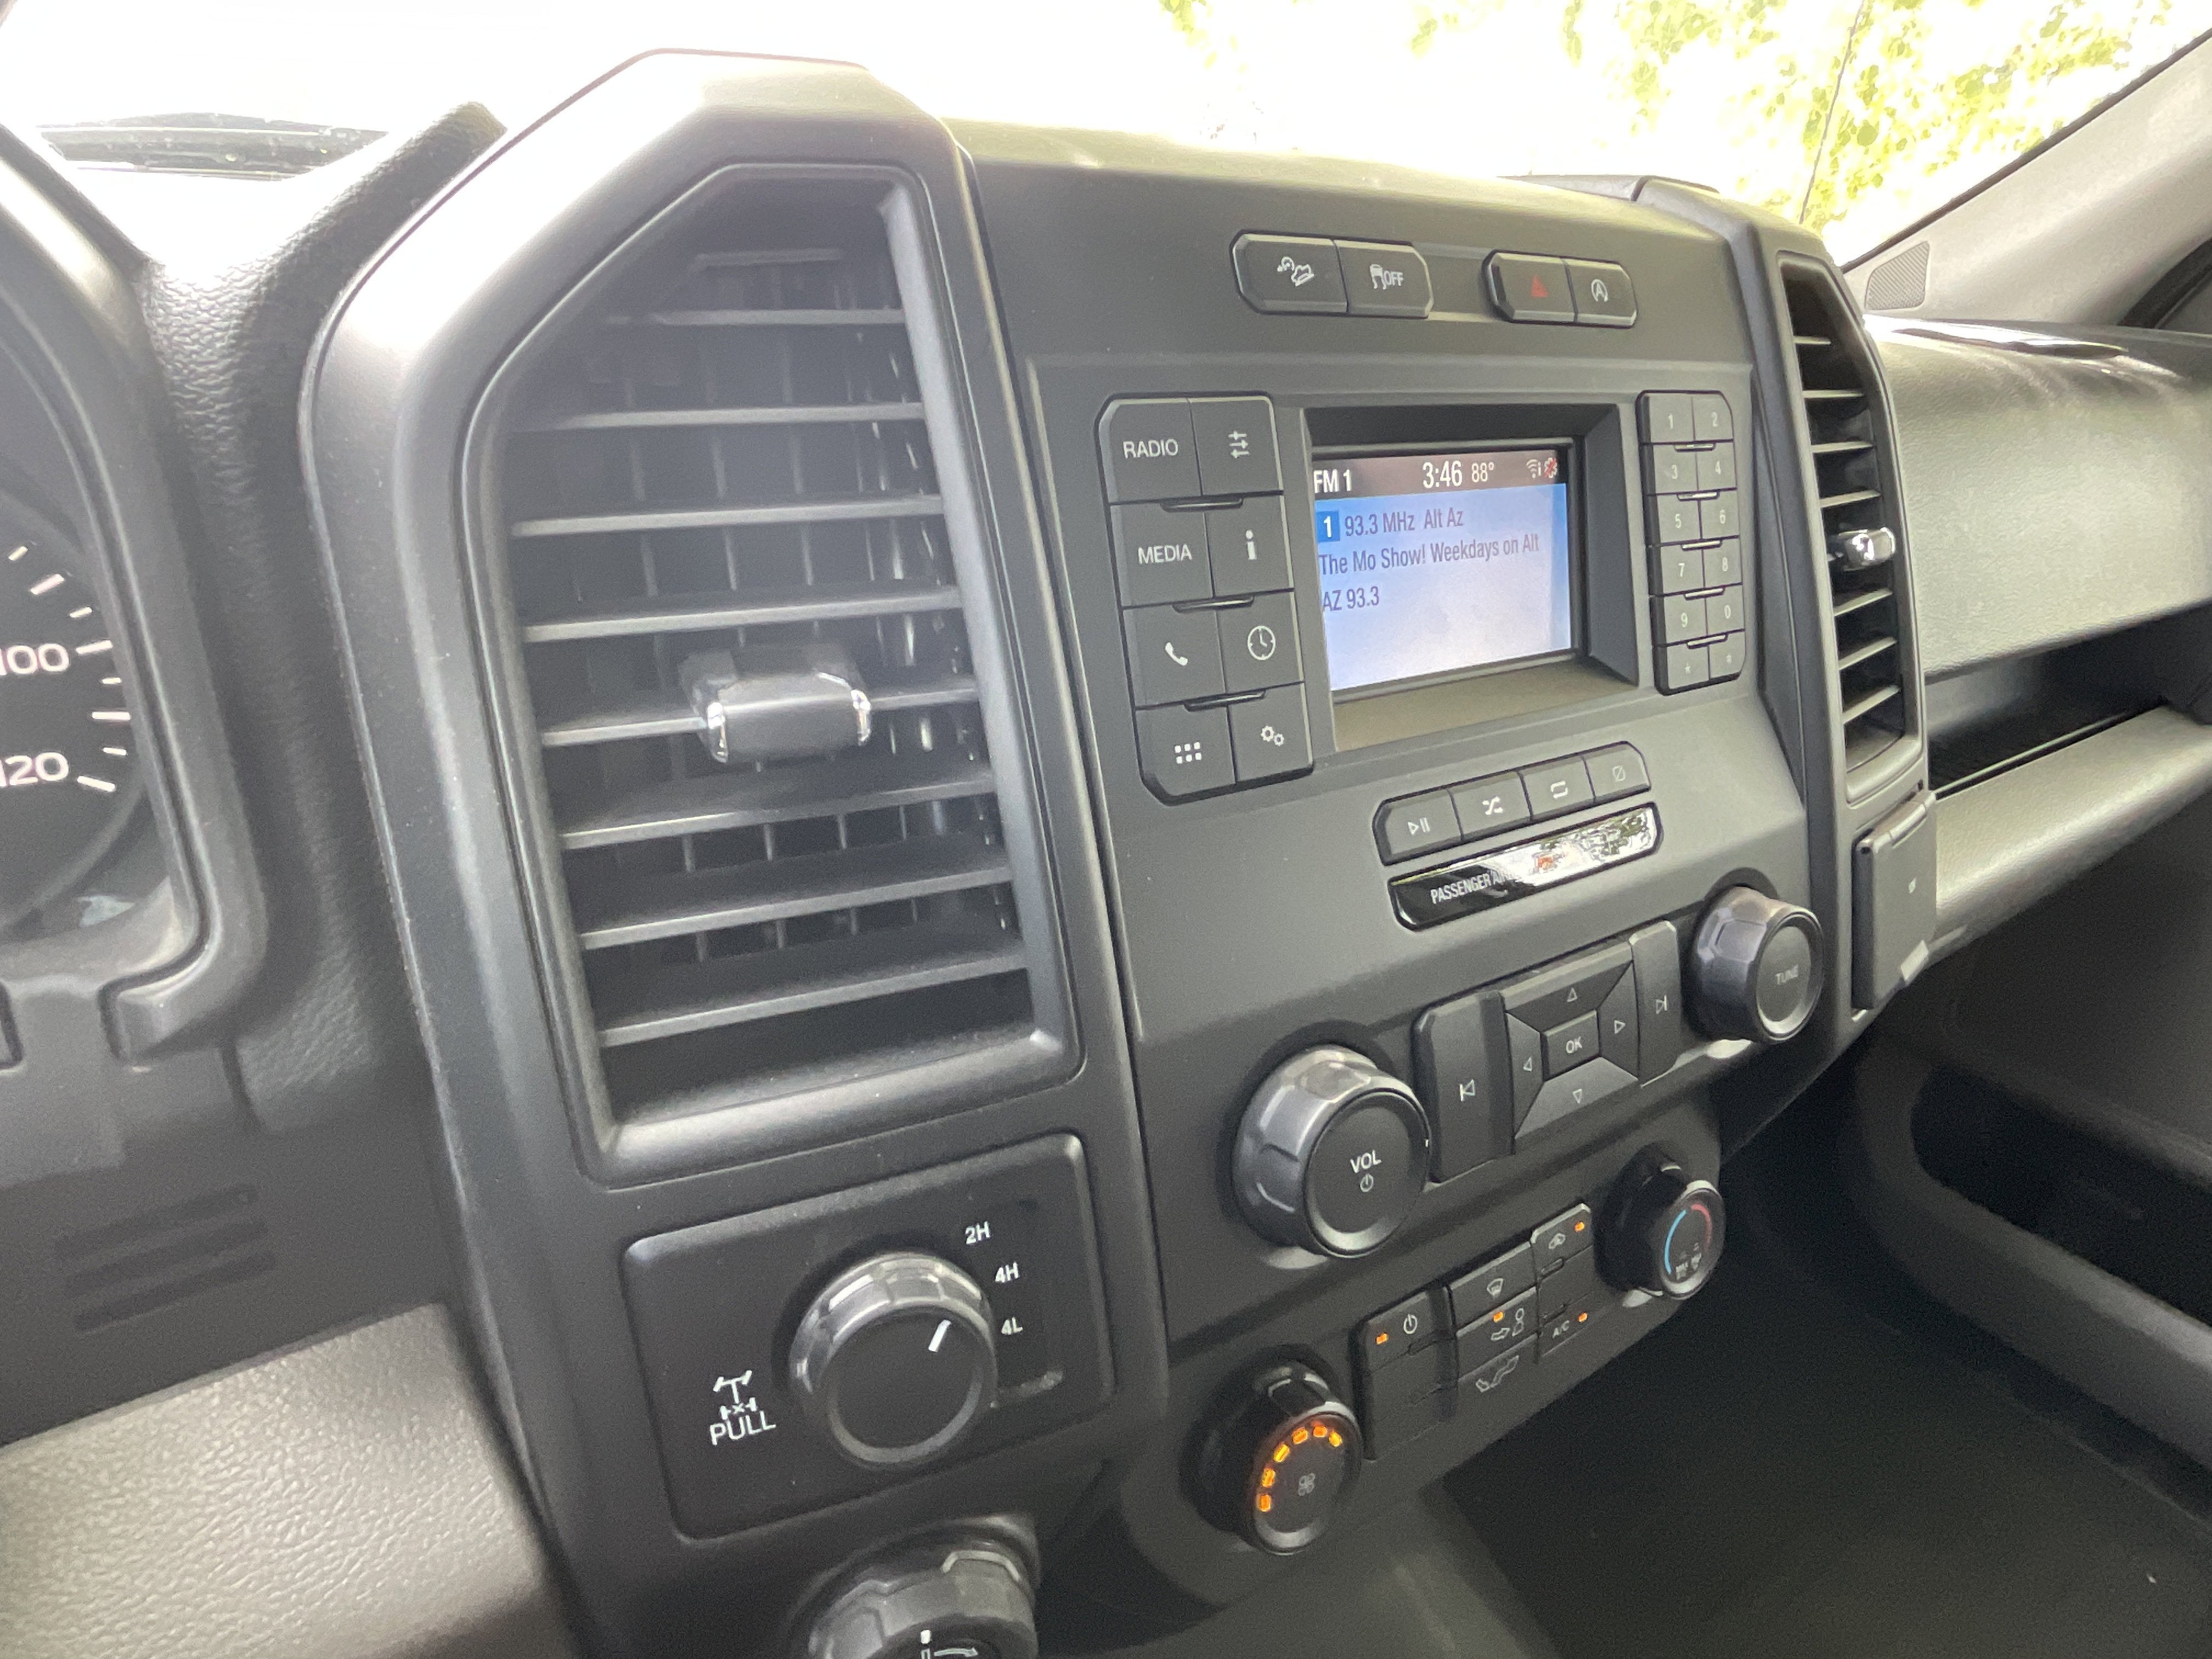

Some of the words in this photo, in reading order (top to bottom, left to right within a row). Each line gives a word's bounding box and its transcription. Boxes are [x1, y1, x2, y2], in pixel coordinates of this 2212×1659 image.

[1384, 270, 1404, 287] OFF
[1668, 414, 1674, 430] 1
[1711, 411, 1718, 427] 2
[1123, 438, 1179, 459] RADIO
[1423, 460, 1463, 488] 3:46
[1471, 462, 1494, 482] 88°
[1671, 464, 1678, 479] 3
[1714, 460, 1722, 476] 4
[1313, 470, 1338, 493] FM
[1343, 469, 1352, 491] 1
[1345, 514, 1378, 537] 93.3
[1383, 511, 1415, 533] MHz
[1424, 508, 1444, 529] Alt
[1447, 507, 1464, 527] Az
[1675, 514, 1681, 529] 5
[1719, 509, 1726, 524] 6
[1323, 516, 1333, 538] 1
[1138, 544, 1192, 564] MEDIA
[1319, 554, 1347, 575] The
[1353, 550, 1376, 572] Mo
[1381, 544, 1426, 568] Show!
[1430, 537, 1499, 562] Weekdays
[1503, 539, 1519, 554] on
[1522, 533, 1539, 552] Alt
[1722, 557, 1729, 571] 8
[1678, 563, 1685, 578] 7
[1323, 589, 1342, 611] AZ
[1347, 586, 1380, 610] 93.3
[1681, 612, 1688, 628] 9
[1724, 605, 1731, 619] 0
[1430, 873, 1491, 904] PASSENGER
[1775, 965, 1798, 985] TUNE
[1566, 1035, 1582, 1054] OK
[1350, 1150, 1381, 1173] VOL
[964, 1221, 990, 1244] 2H
[995, 1262, 1019, 1283] 4H
[1001, 1318, 1023, 1335] 4L
[1553, 1321, 1570, 1338] A/C
[709, 1410, 776, 1446] PULL
